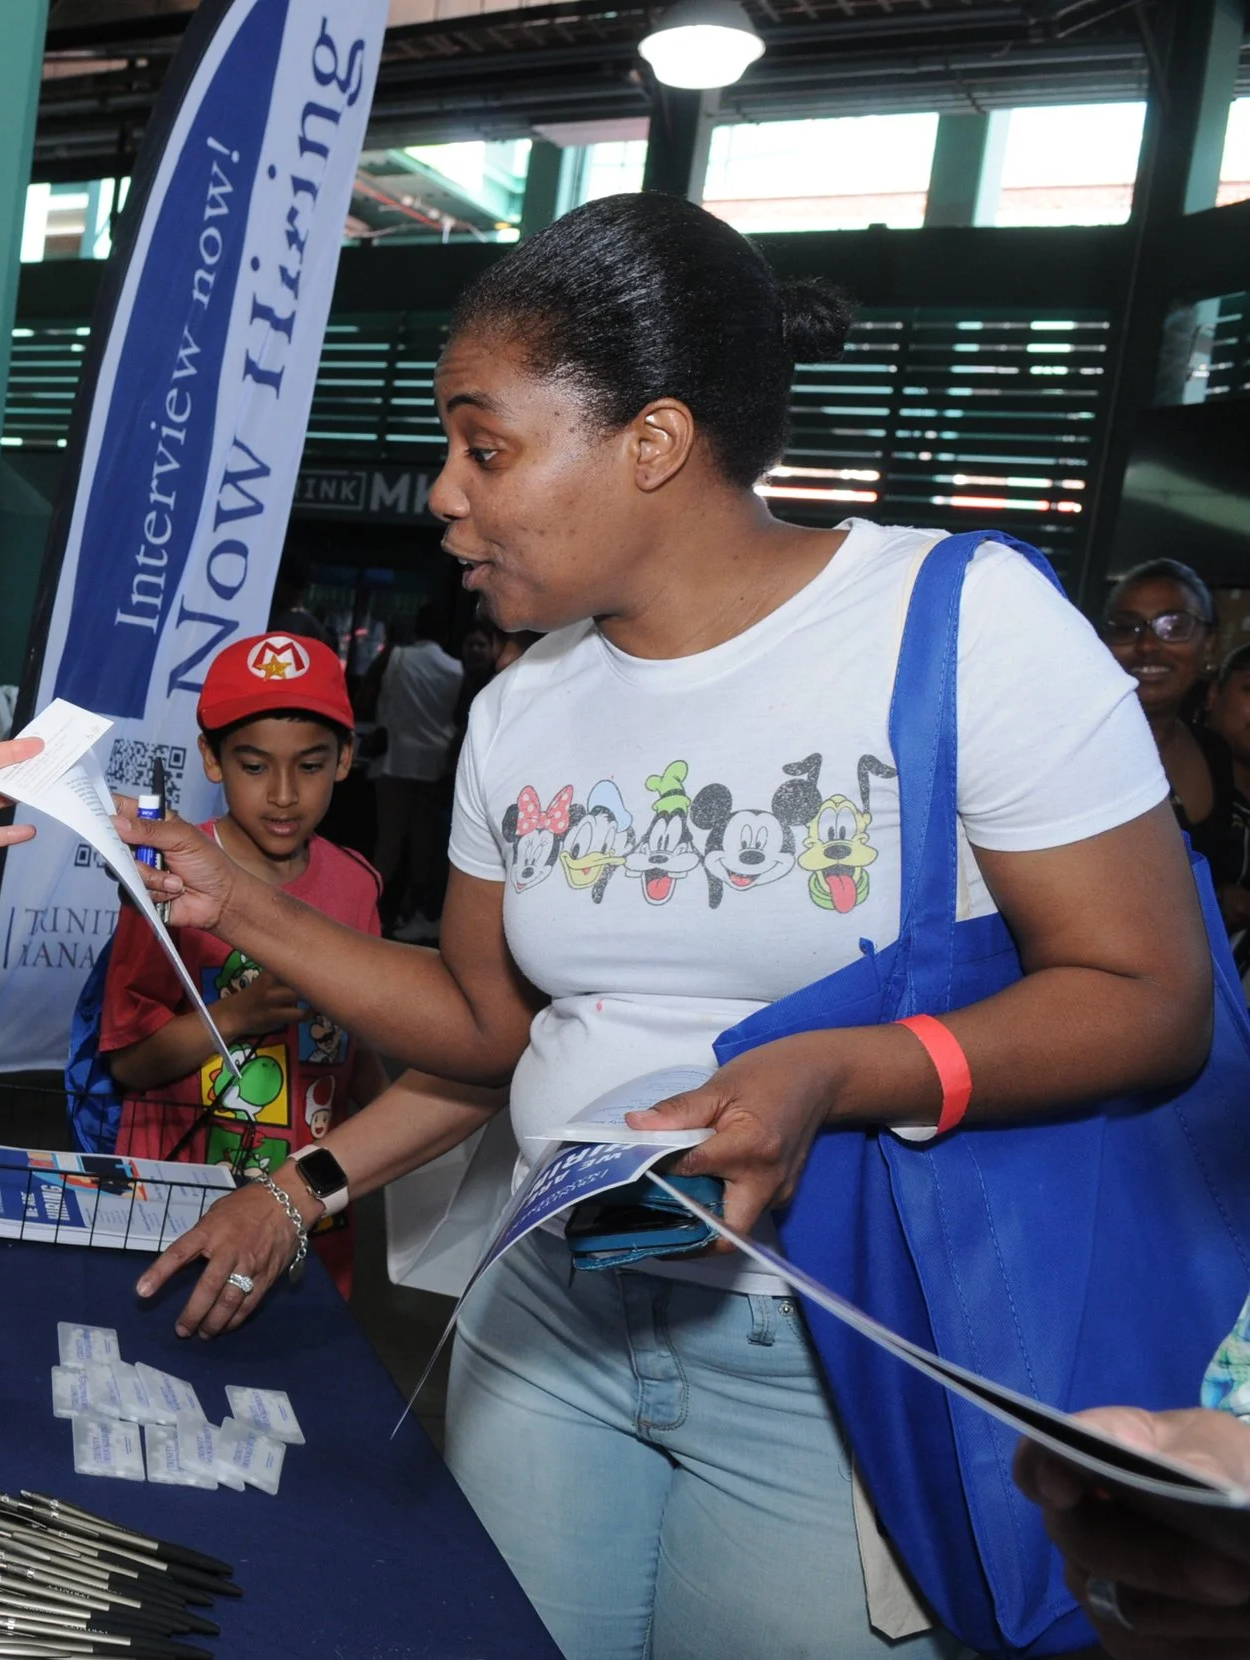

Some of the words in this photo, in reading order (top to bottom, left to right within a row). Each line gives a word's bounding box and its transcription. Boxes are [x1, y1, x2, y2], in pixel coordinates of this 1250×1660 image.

[166, 434, 271, 699] Now
[243, 16, 365, 400] Hiring
[114, 324, 202, 635] Interview
[192, 135, 240, 310] now!
[298, 477, 359, 501] INK
[578, 1151, 623, 1172] WE
[40, 1184, 70, 1221] HIRING
